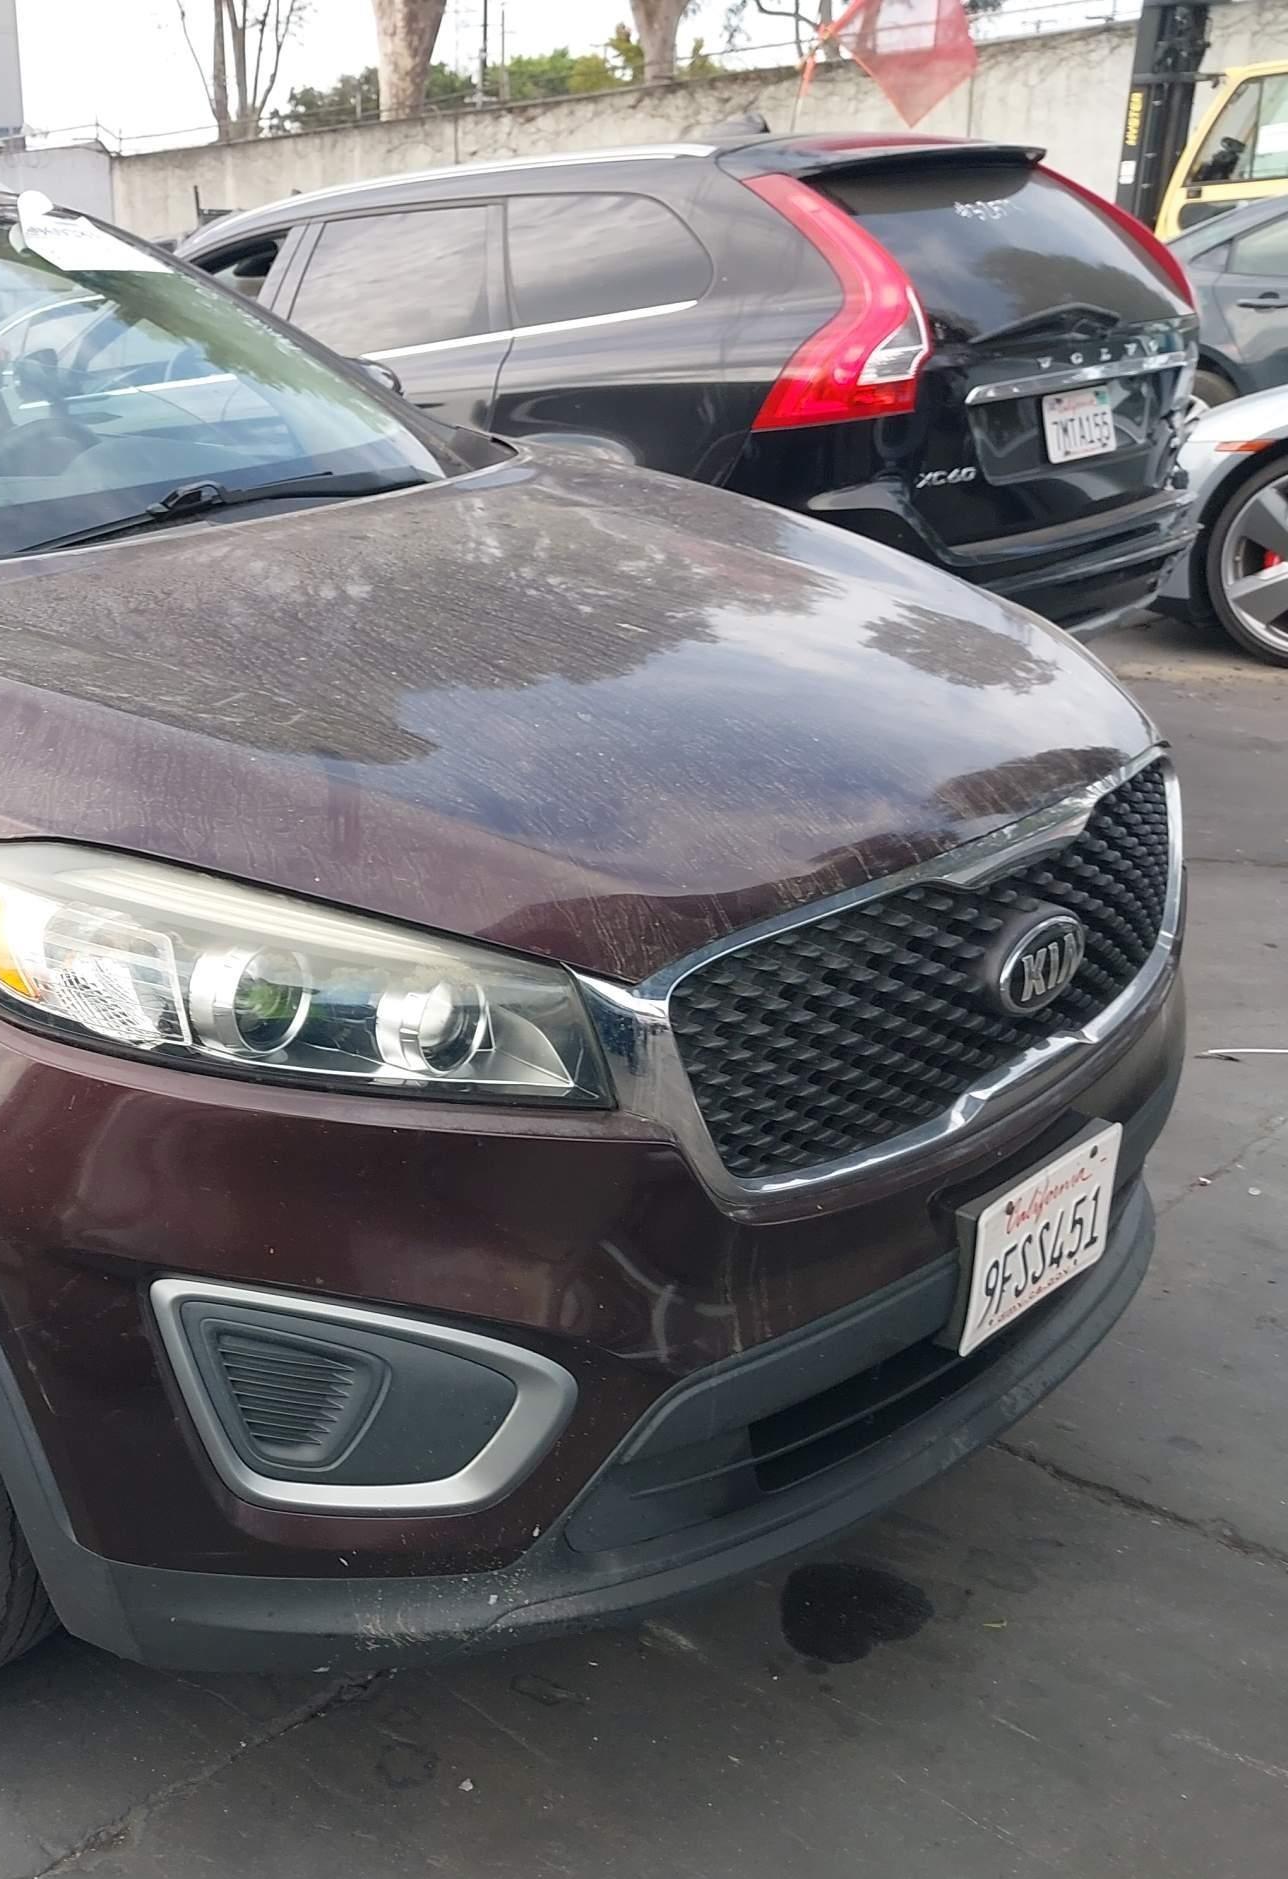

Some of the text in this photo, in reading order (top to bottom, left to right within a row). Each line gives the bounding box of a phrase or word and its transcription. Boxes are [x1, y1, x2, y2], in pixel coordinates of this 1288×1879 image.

[915, 466, 976, 488] XC60
[1021, 932, 1079, 1002] KIA
[1006, 1167, 1092, 1234] California
[977, 1186, 1100, 1328] 9FSS451
